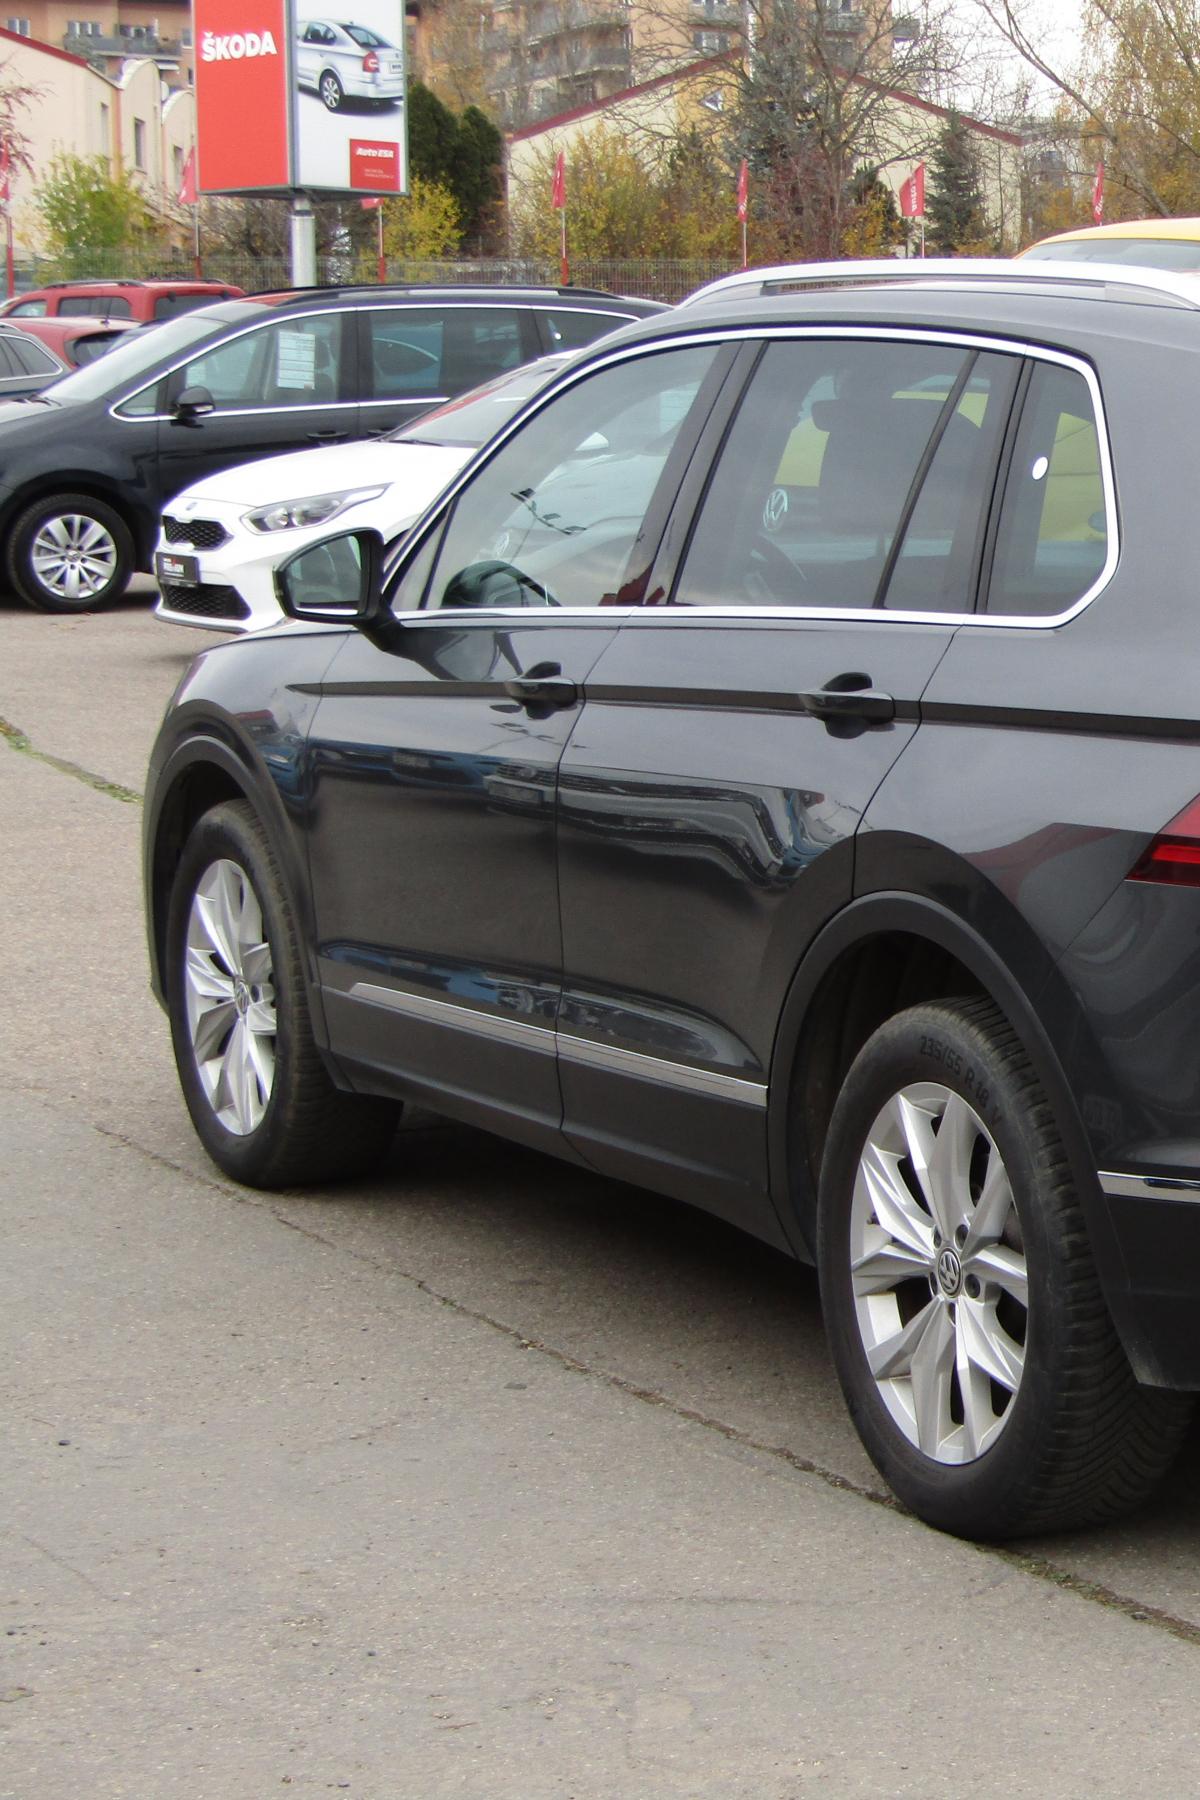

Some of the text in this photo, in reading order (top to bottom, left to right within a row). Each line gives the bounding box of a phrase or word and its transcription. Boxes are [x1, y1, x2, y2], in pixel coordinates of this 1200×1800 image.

[202, 31, 277, 62] ŠKODA
[356, 147, 394, 159] Auto ESA
